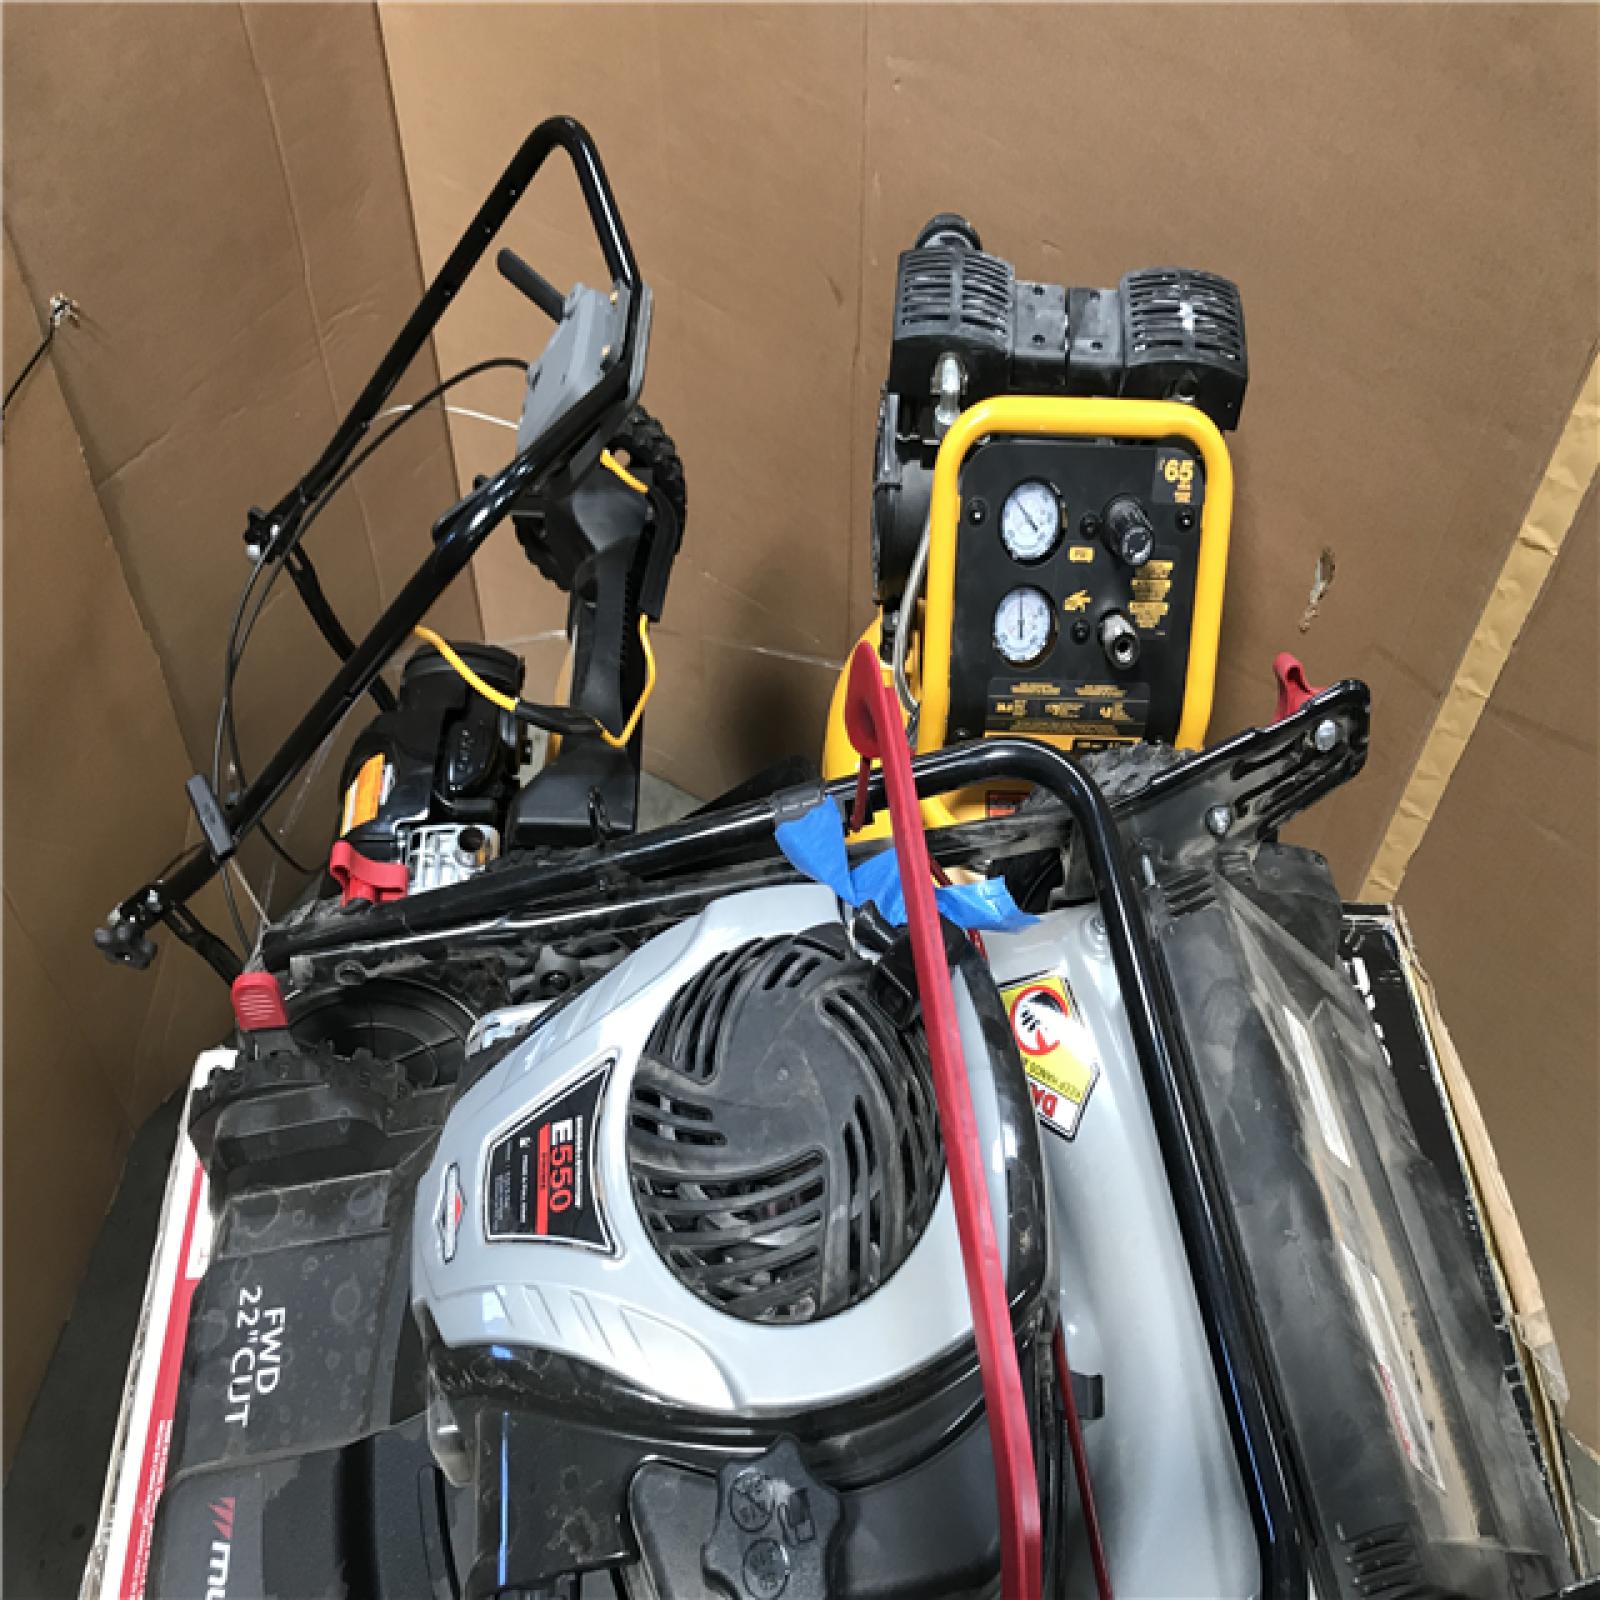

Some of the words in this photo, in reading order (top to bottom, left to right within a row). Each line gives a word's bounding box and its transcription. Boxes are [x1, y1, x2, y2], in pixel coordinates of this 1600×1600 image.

[1165, 459, 1195, 483] 65
[549, 1119, 574, 1213] E550
[255, 1306, 285, 1395] FWD
